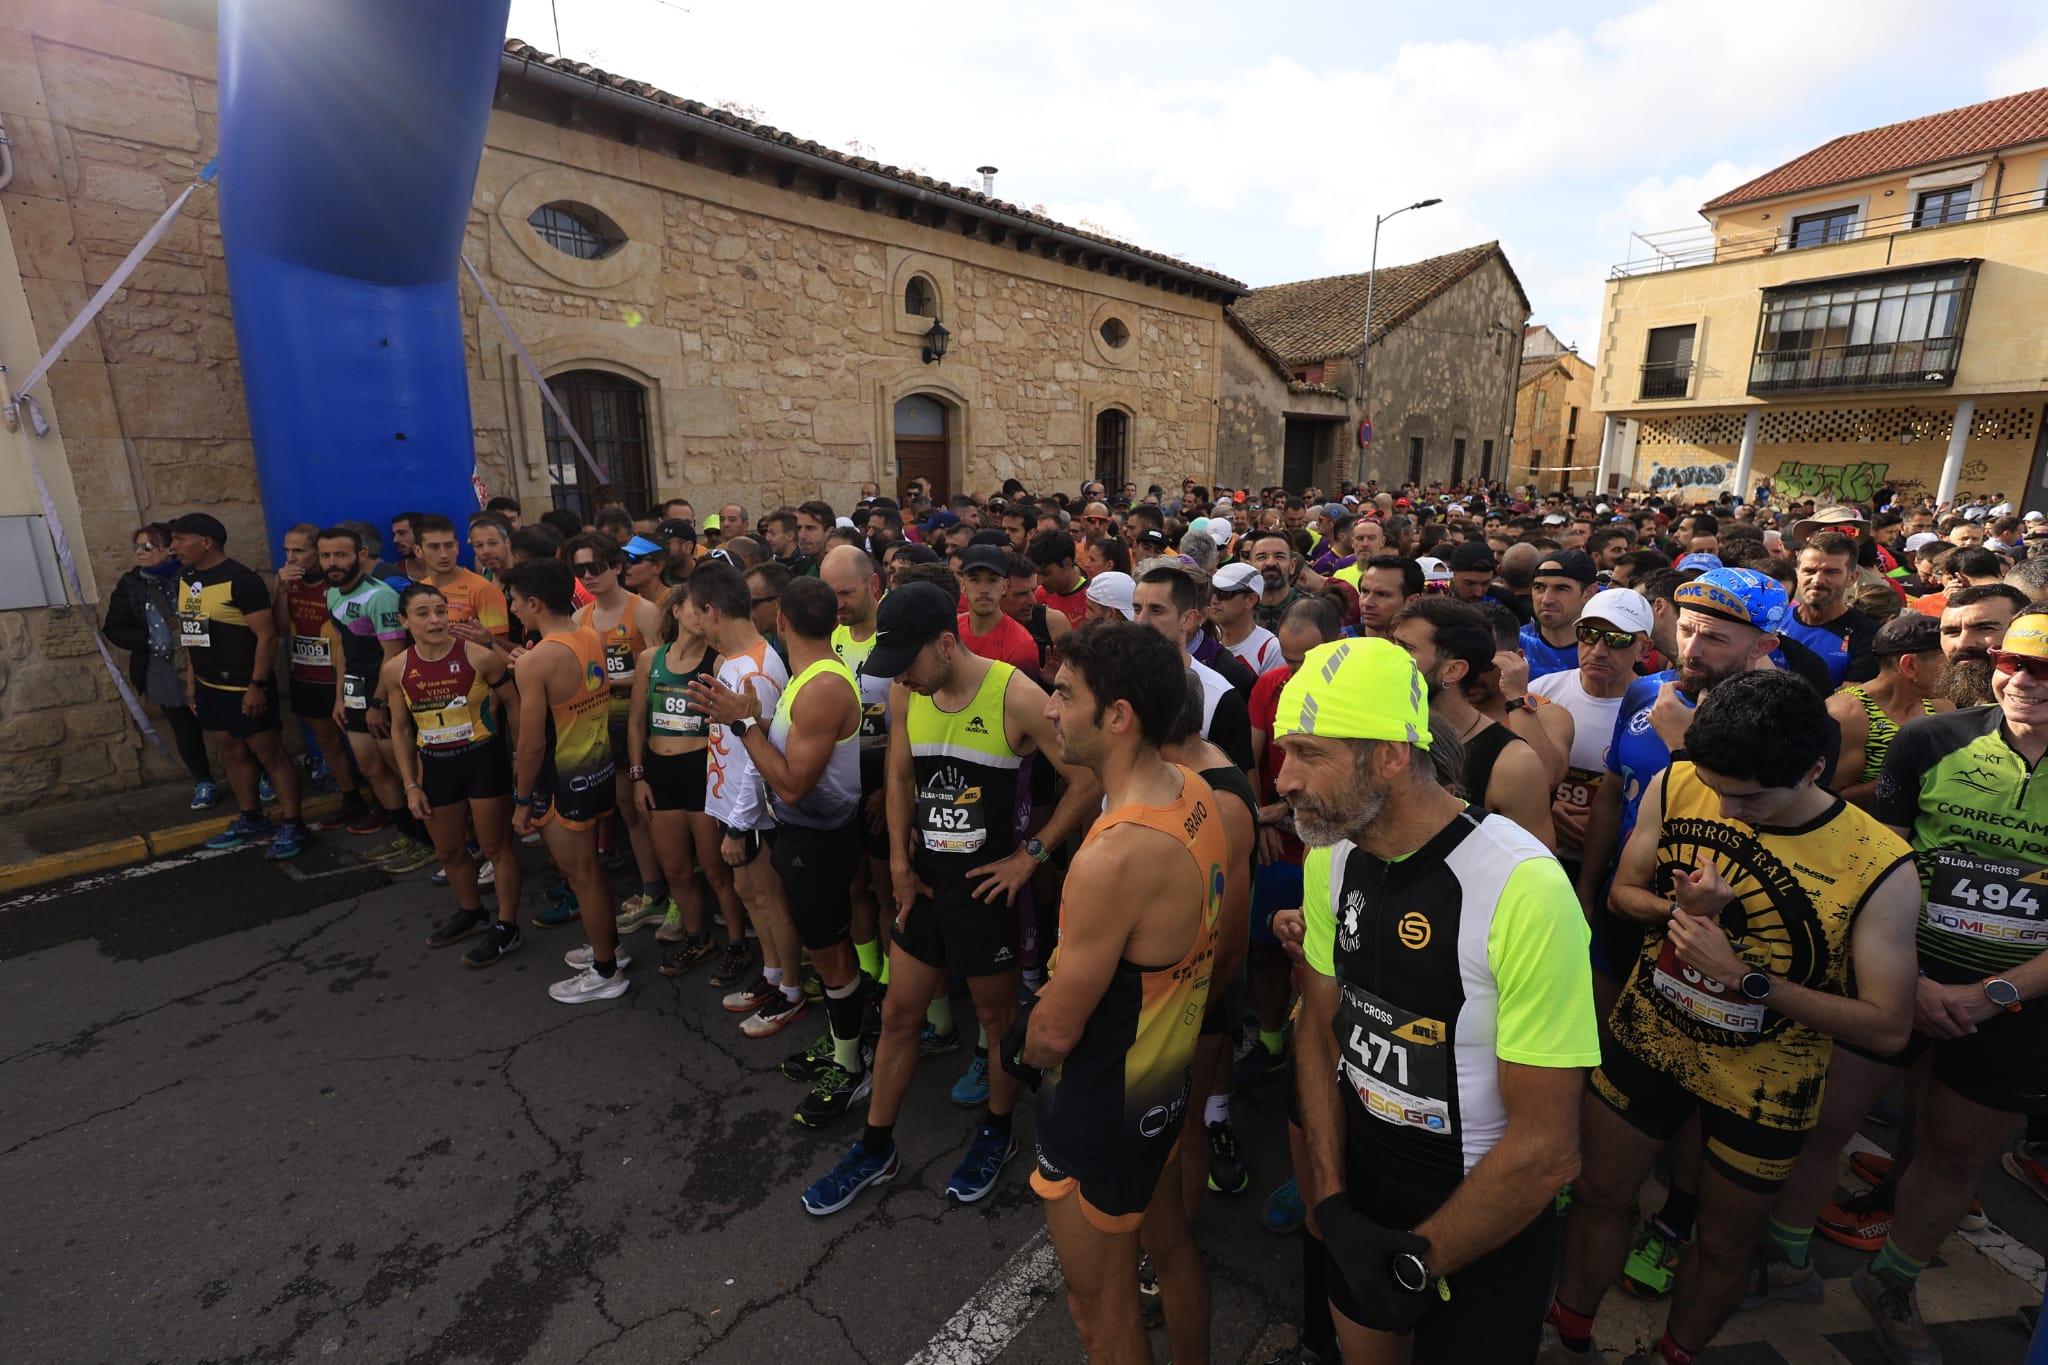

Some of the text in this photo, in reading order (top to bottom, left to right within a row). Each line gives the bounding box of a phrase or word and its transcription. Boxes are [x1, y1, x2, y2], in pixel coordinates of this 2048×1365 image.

[182, 620, 203, 634] 682
[296, 643, 325, 657] 1009
[606, 657, 625, 672] 85
[426, 687, 450, 696] VINO
[665, 697, 687, 714] 69
[436, 712, 445, 726] 1
[1555, 782, 1589, 806] 59
[928, 807, 970, 830] 452
[1184, 801, 1208, 839] BRAVO
[1670, 822, 1742, 849] PORROS
[1751, 845, 1795, 897] RAIL
[1938, 855, 1951, 865] 33
[1950, 856, 1974, 870] LIGA
[1983, 863, 2020, 877] CROSS
[1345, 889, 1367, 916] MOLLY
[1950, 877, 2040, 916] 494
[1363, 1002, 1393, 1026] CROSS
[1659, 981, 1759, 1030] JOMISAGA
[1349, 1023, 1409, 1087] 471
